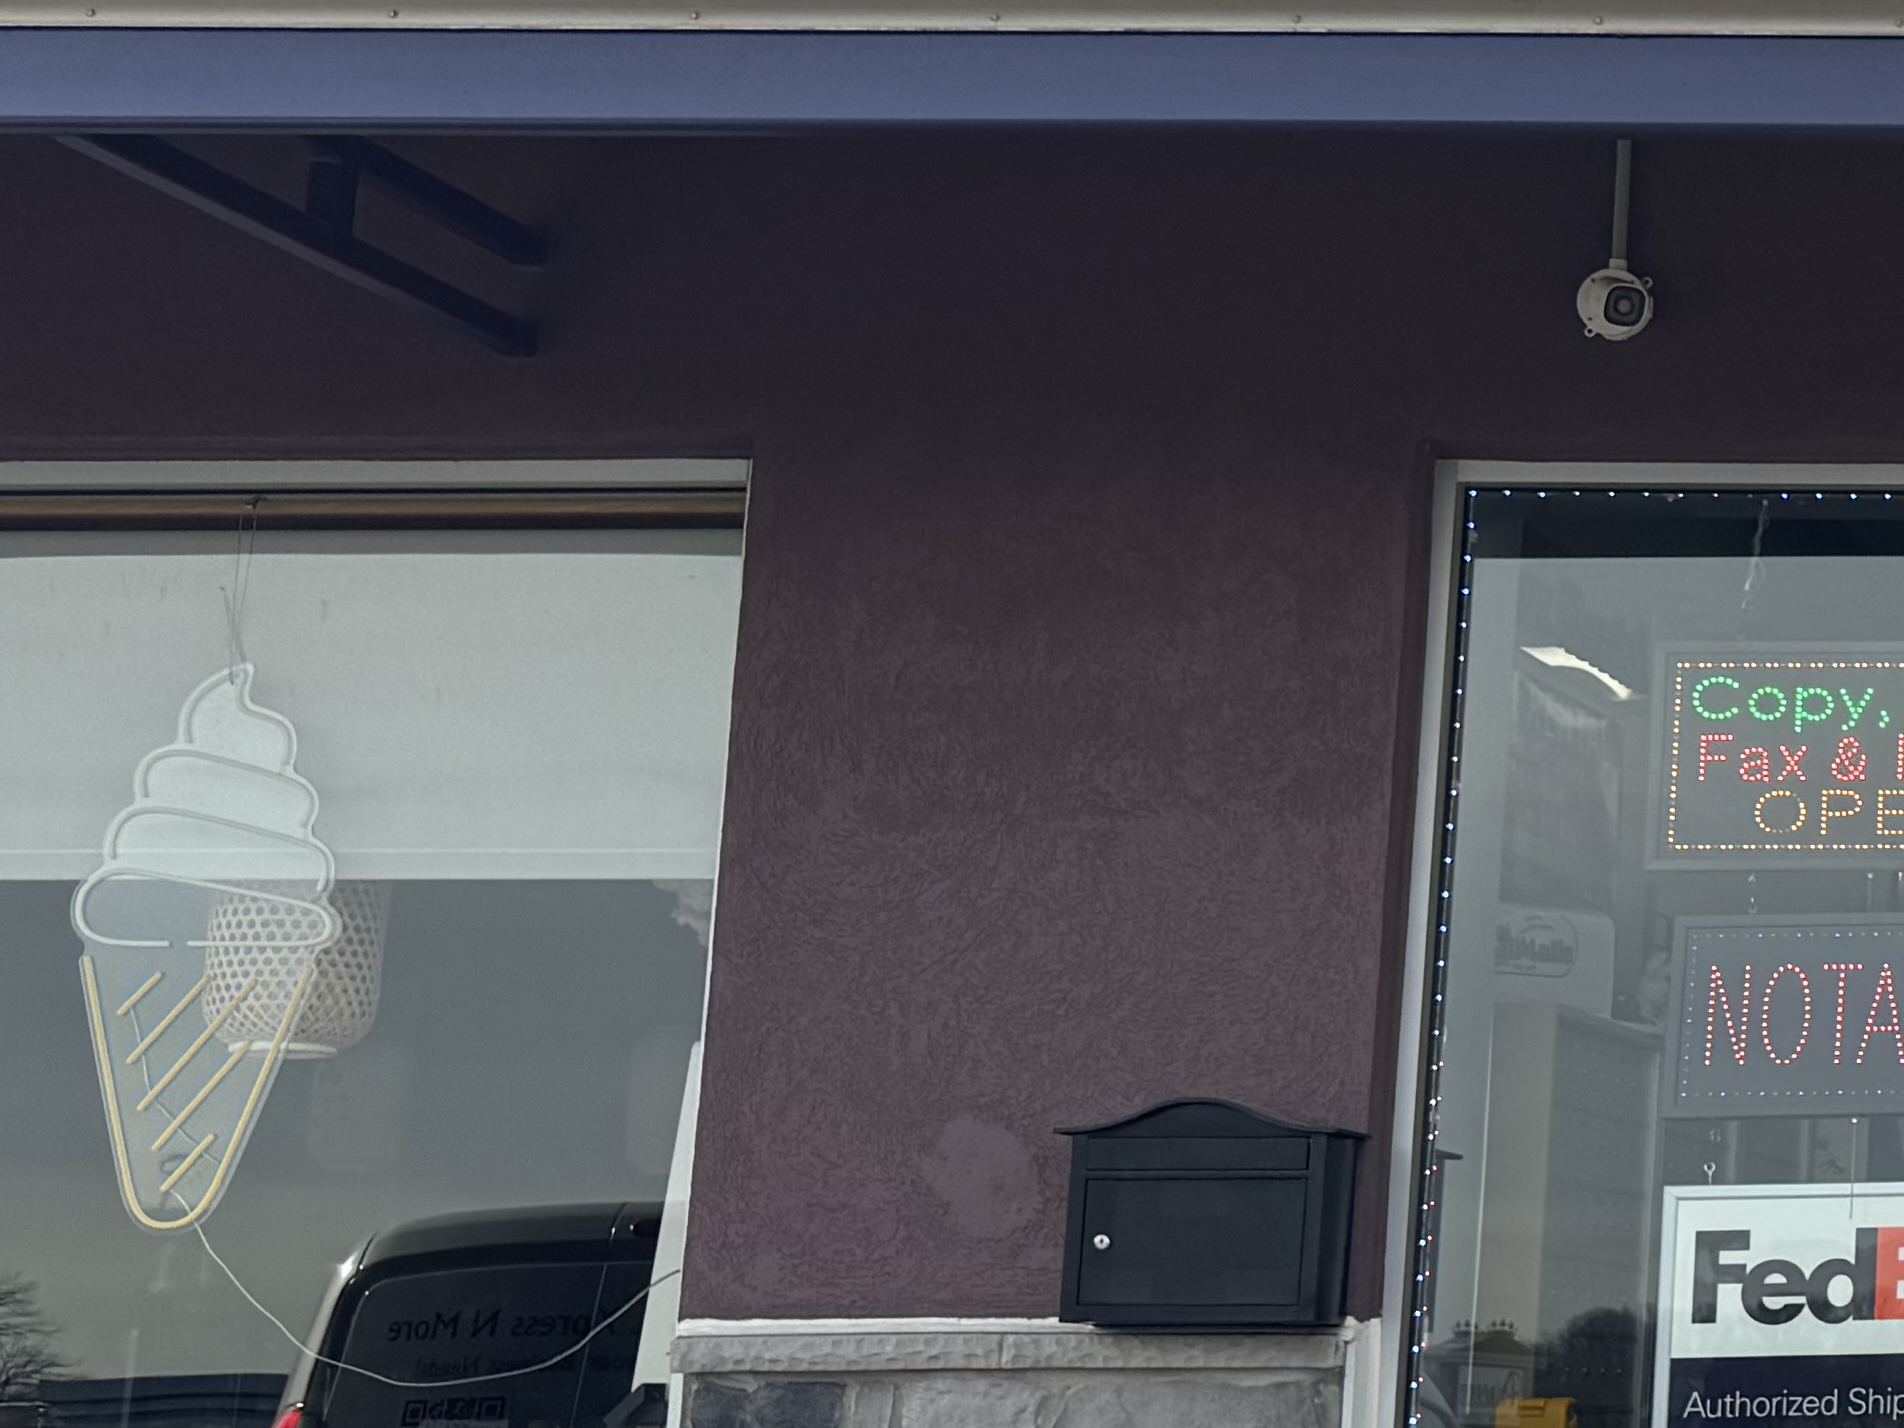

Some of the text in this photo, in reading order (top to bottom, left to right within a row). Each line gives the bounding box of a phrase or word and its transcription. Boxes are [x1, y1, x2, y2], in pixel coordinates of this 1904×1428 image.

[1691, 676, 1890, 732] Copy,
[1698, 734, 1807, 783] Fax
[1831, 736, 1866, 781] &
[1682, 1390, 1839, 1420] Authorized
